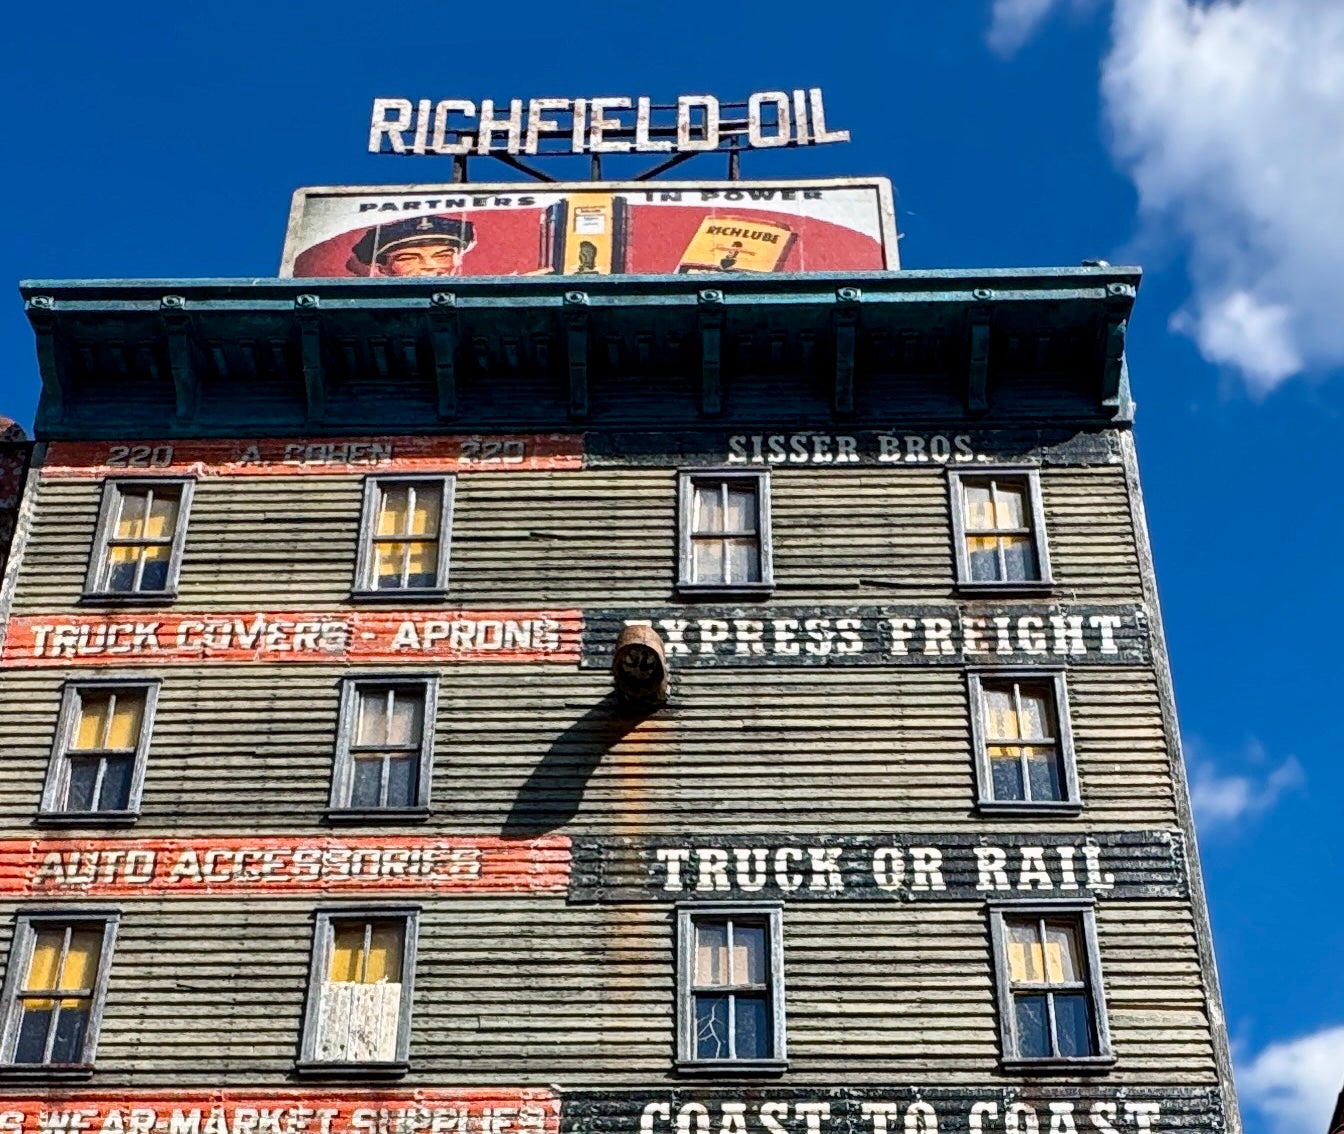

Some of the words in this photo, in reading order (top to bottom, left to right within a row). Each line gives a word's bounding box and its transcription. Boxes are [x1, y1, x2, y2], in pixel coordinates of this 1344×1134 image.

[368, 94, 722, 155] RICHFIELD
[746, 88, 851, 148] OIL
[358, 196, 537, 213] PARTNERS
[700, 190, 824, 202] POWER
[105, 445, 175, 468] 220
[283, 442, 395, 466] COHEN
[459, 440, 527, 465] 220
[727, 435, 860, 463] SISSER
[877, 434, 993, 463] BROS.
[31, 620, 164, 656] TRUCK
[176, 616, 349, 656] COVERS
[391, 618, 559, 651] APRONS
[624, 617, 864, 657] XPRESS
[890, 614, 1123, 656] FREIGHT
[33, 848, 158, 885] AUTO
[168, 846, 485, 884] ACCESSORIES
[656, 846, 845, 892] TRUCK
[872, 846, 948, 892] OR
[975, 845, 1116, 892] RAIL
